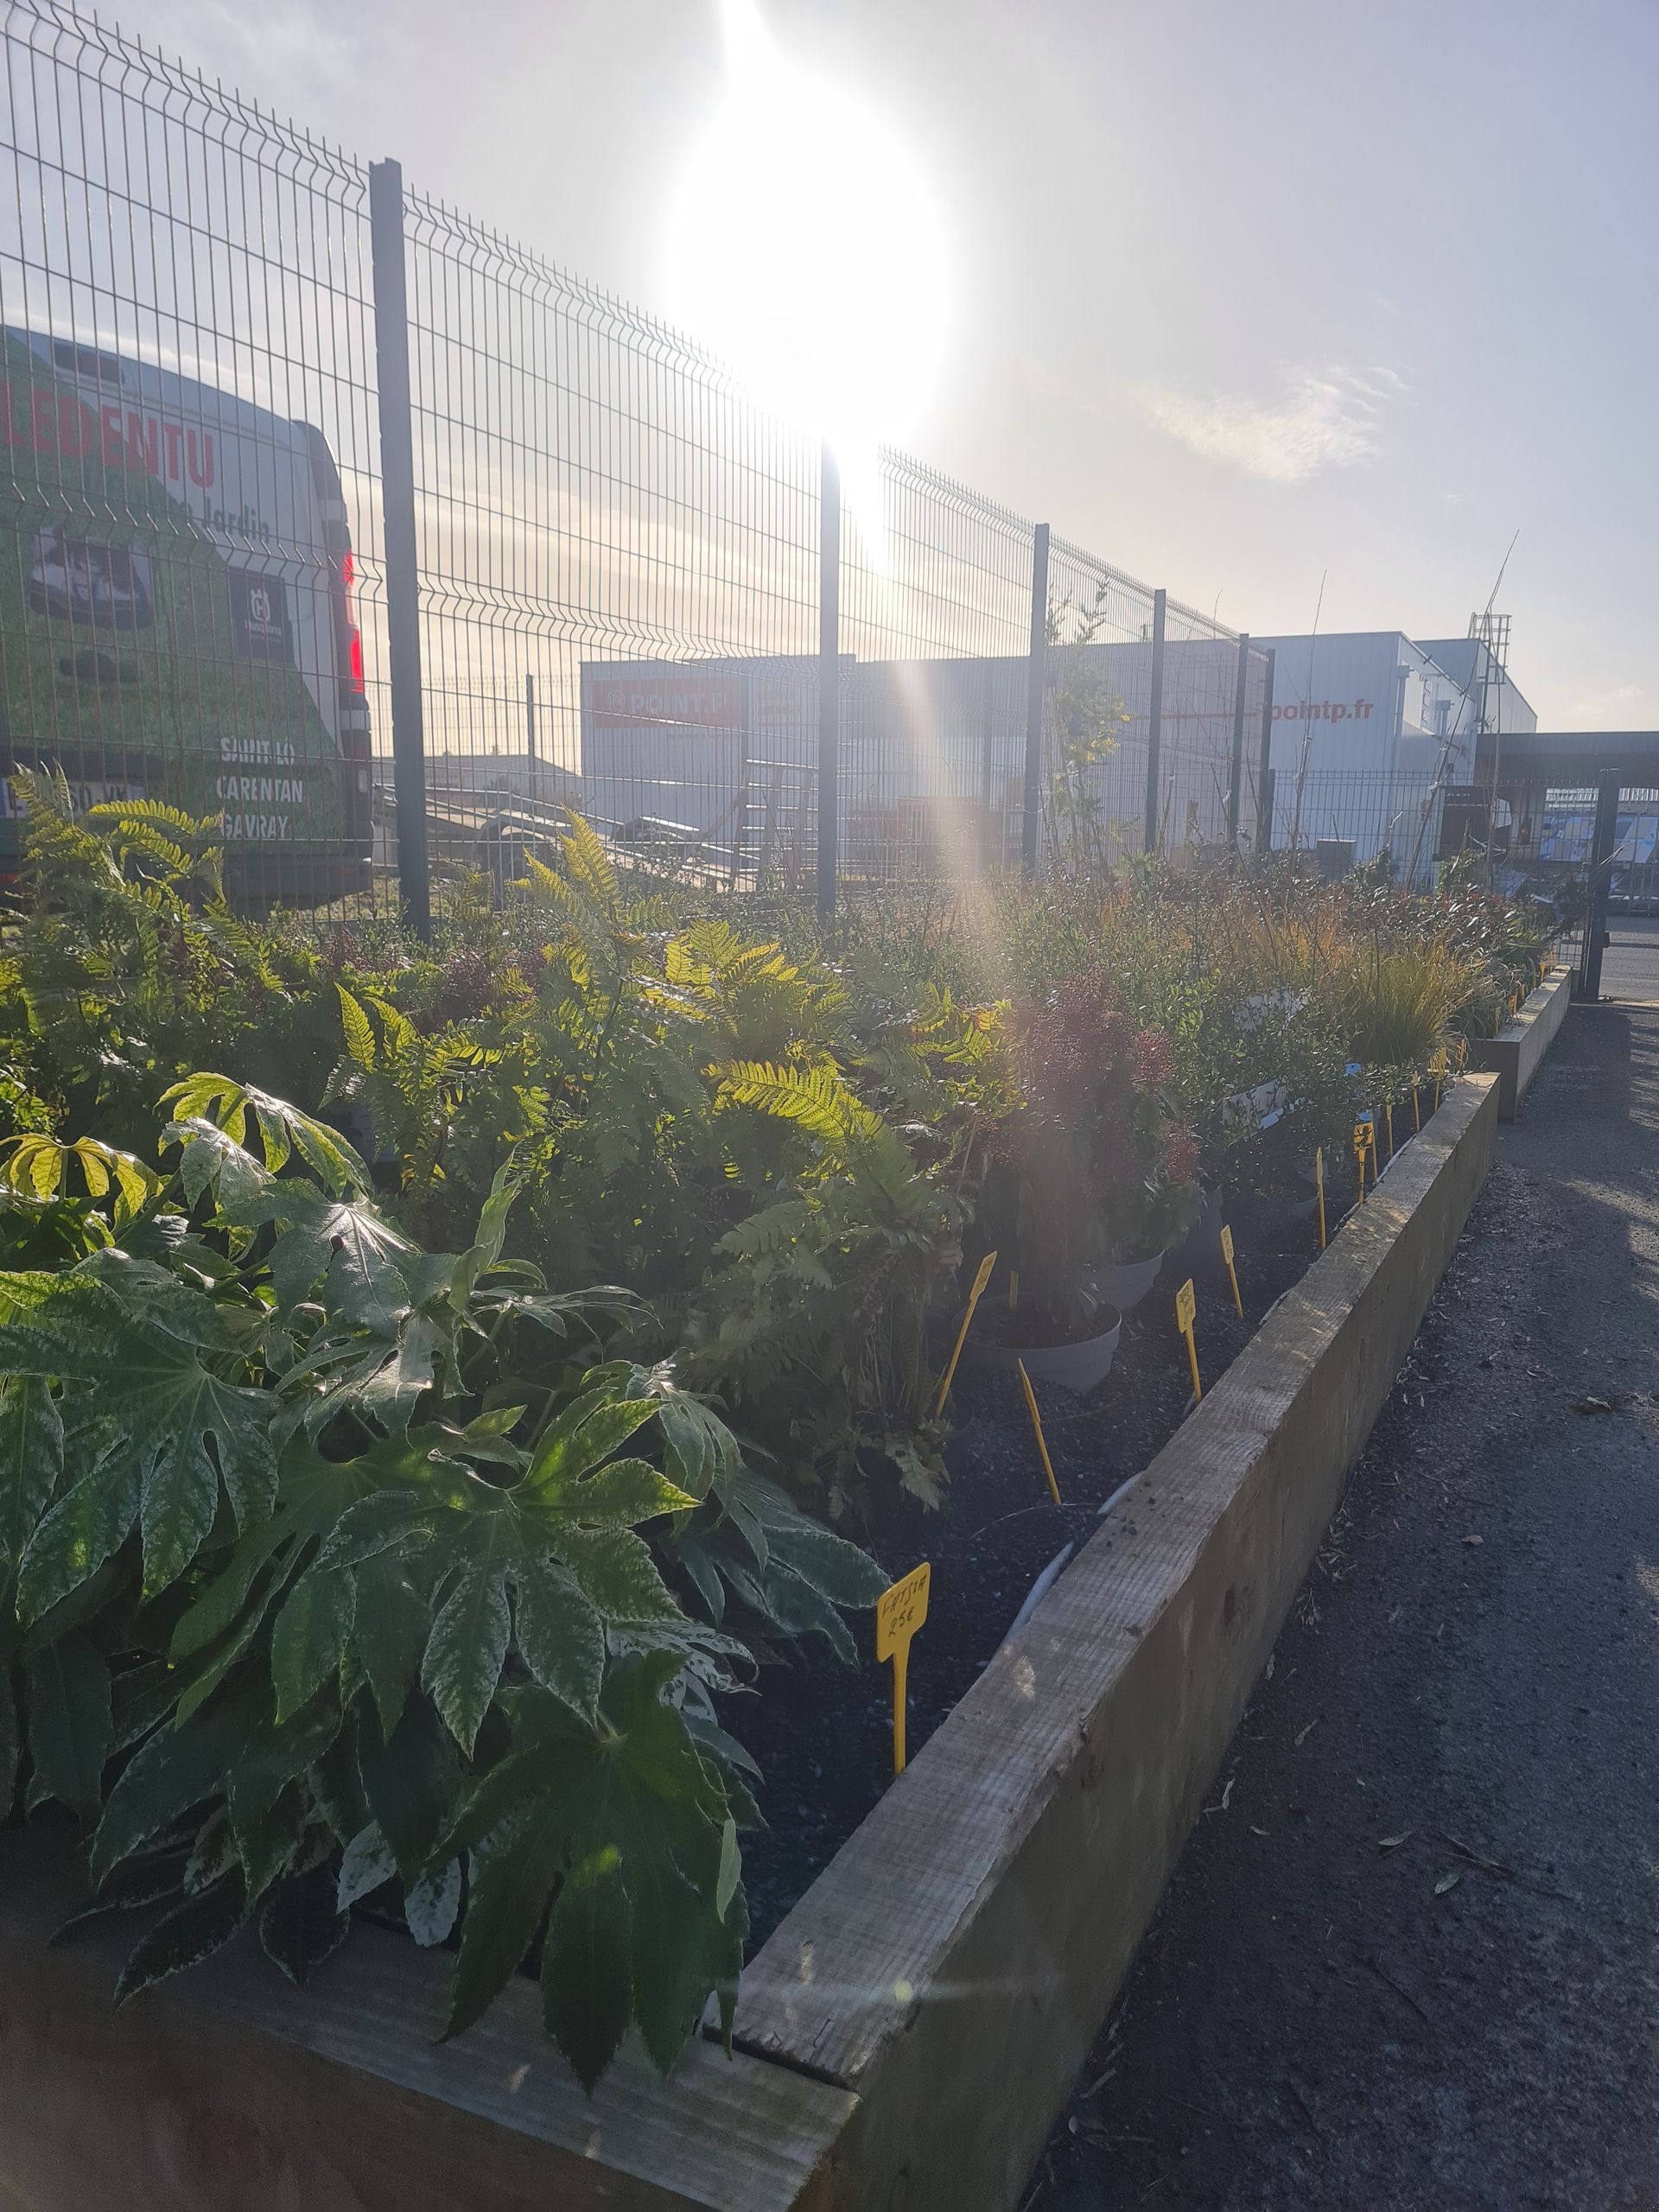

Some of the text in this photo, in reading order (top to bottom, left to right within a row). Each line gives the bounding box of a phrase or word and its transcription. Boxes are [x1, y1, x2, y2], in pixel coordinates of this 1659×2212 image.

[0, 379, 215, 489] LEDENTU
[216, 775, 303, 803] CARENTAN
[221, 813, 289, 840] GAVRAY
